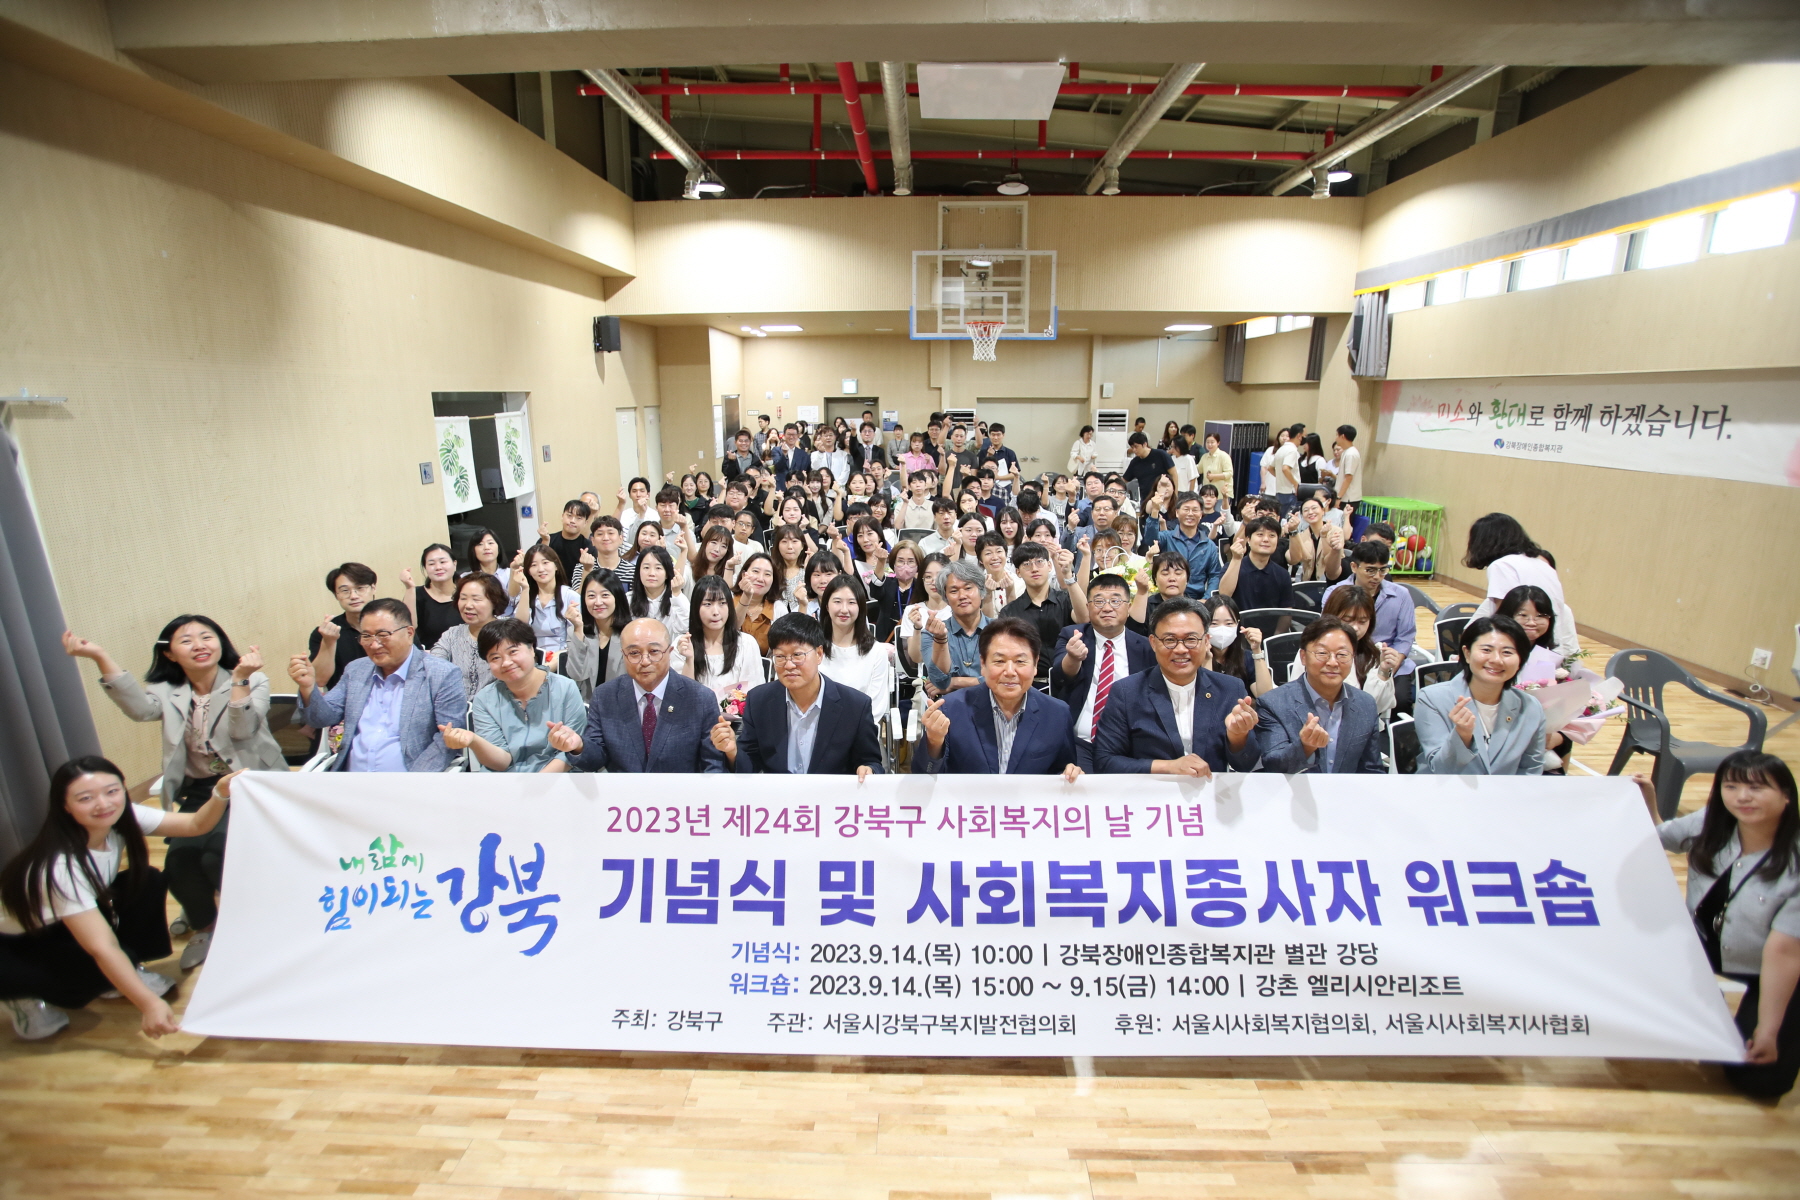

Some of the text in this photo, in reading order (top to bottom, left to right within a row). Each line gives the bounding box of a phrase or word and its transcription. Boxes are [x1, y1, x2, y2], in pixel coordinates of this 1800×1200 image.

[1552, 402, 1592, 432] 함께
[1599, 404, 1733, 441] 하겠습니다.
[606, 803, 1204, 839] 2023년 제24회 강북구 사회복지의 날 기념
[598, 857, 1601, 929] 기념식 및 사회복지종사자 워크숍
[731, 941, 800, 965] 기념식:
[810, 942, 961, 967] 2023.9.14.(목)
[971, 944, 1034, 965] 10:00
[1059, 942, 1276, 967] 강북장애인종합복지관
[1284, 942, 1328, 966] 별관
[1336, 942, 1379, 967] 강당
[728, 972, 799, 996] 워크숍:
[809, 973, 962, 999] 2023.9.14.(목)
[971, 975, 1034, 997] 15:00
[1070, 973, 1156, 1000] 9.15(금)
[1166, 975, 1230, 997] 14:00
[1255, 973, 1299, 998] 강촌
[1307, 974, 1465, 998] 엘리시안리조트
[611, 1009, 724, 1032] 주최: 강북구
[766, 1012, 1076, 1036] 주관: 서울시강북구복지발전협의회
[1114, 1012, 1590, 1036] 후원: 서울시사회복지협의회, 서울시사회복지사협회
